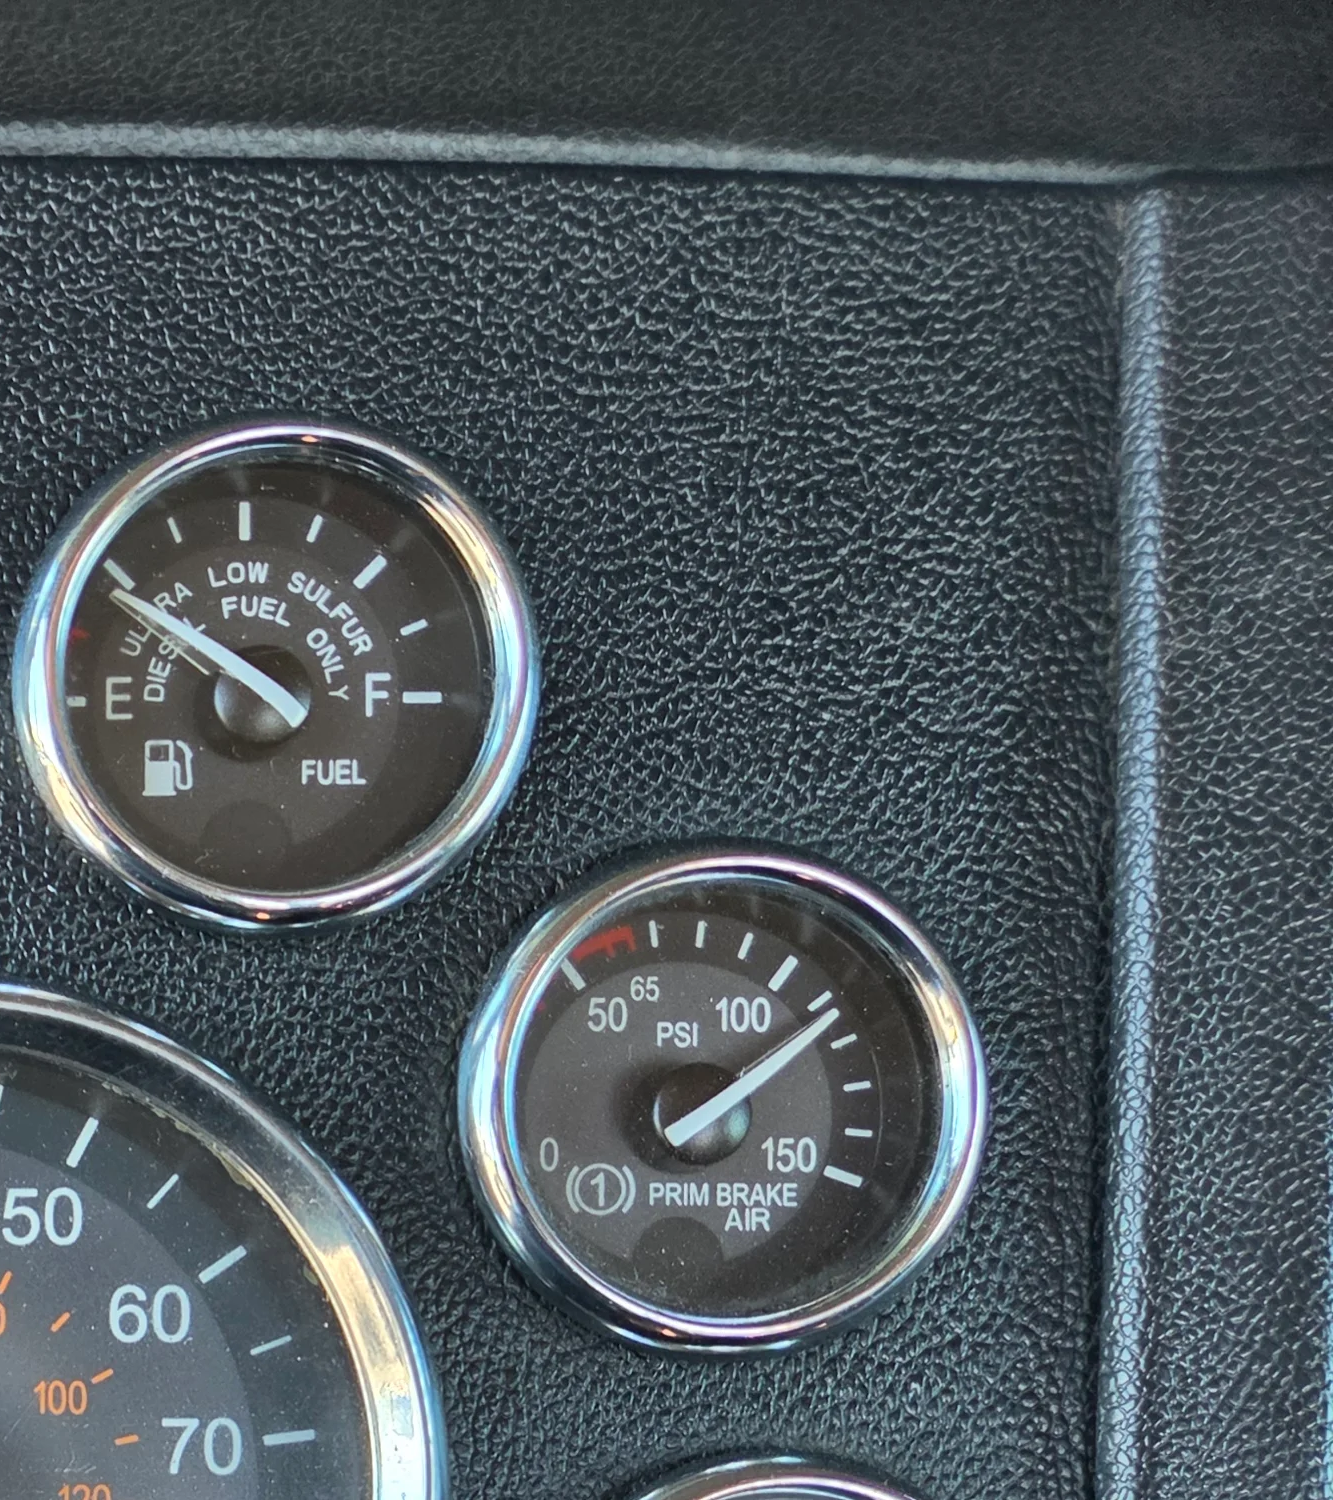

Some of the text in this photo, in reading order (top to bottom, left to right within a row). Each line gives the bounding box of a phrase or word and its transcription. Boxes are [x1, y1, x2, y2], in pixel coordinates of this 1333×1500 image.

[119, 561, 373, 657] ULRA LOW SULFUR
[143, 595, 350, 702] DIESL FUEL ONLY
[106, 676, 133, 720] E
[365, 672, 392, 717] F
[301, 759, 366, 786] FUEL
[630, 975, 660, 1003] 65
[587, 996, 628, 1033] 50
[715, 996, 771, 1033] 100
[656, 1022, 699, 1048] PSI
[539, 1136, 559, 1172] 0
[761, 1136, 817, 1173] 150
[649, 1182, 798, 1207] PRIM BRAKE
[2, 1187, 83, 1247] 50
[724, 1207, 770, 1232] AIR
[108, 1283, 191, 1344] 60
[34, 1380, 87, 1415] 100
[160, 1415, 242, 1475] 70
